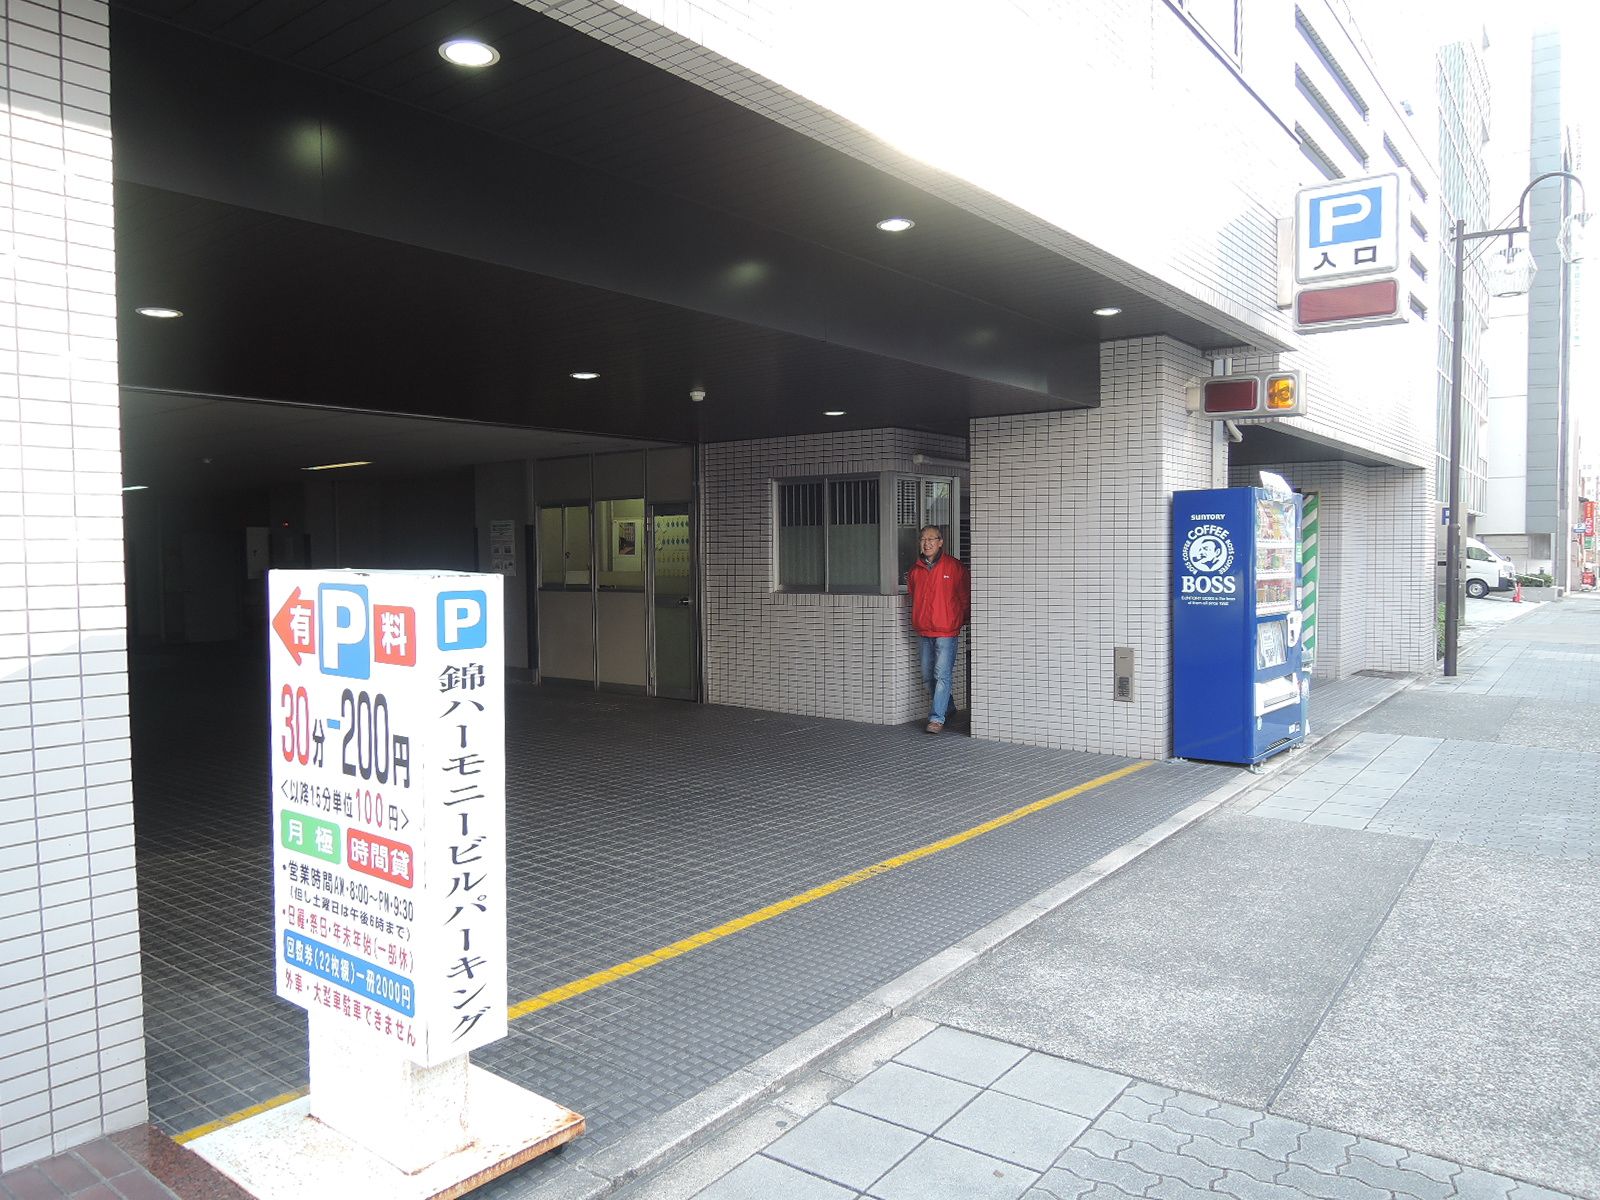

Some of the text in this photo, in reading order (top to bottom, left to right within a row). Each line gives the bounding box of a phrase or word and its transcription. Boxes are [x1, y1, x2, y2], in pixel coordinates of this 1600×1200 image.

[1319, 193, 1371, 243] P
[1313, 245, 1377, 271] 入口
[1188, 525, 1229, 540] COFFEE
[1181, 576, 1236, 594] BOSS
[444, 598, 481, 645] P
[350, 837, 410, 880] 時間貸
[438, 663, 487, 1044] 錦ハーモニービルパーキング
